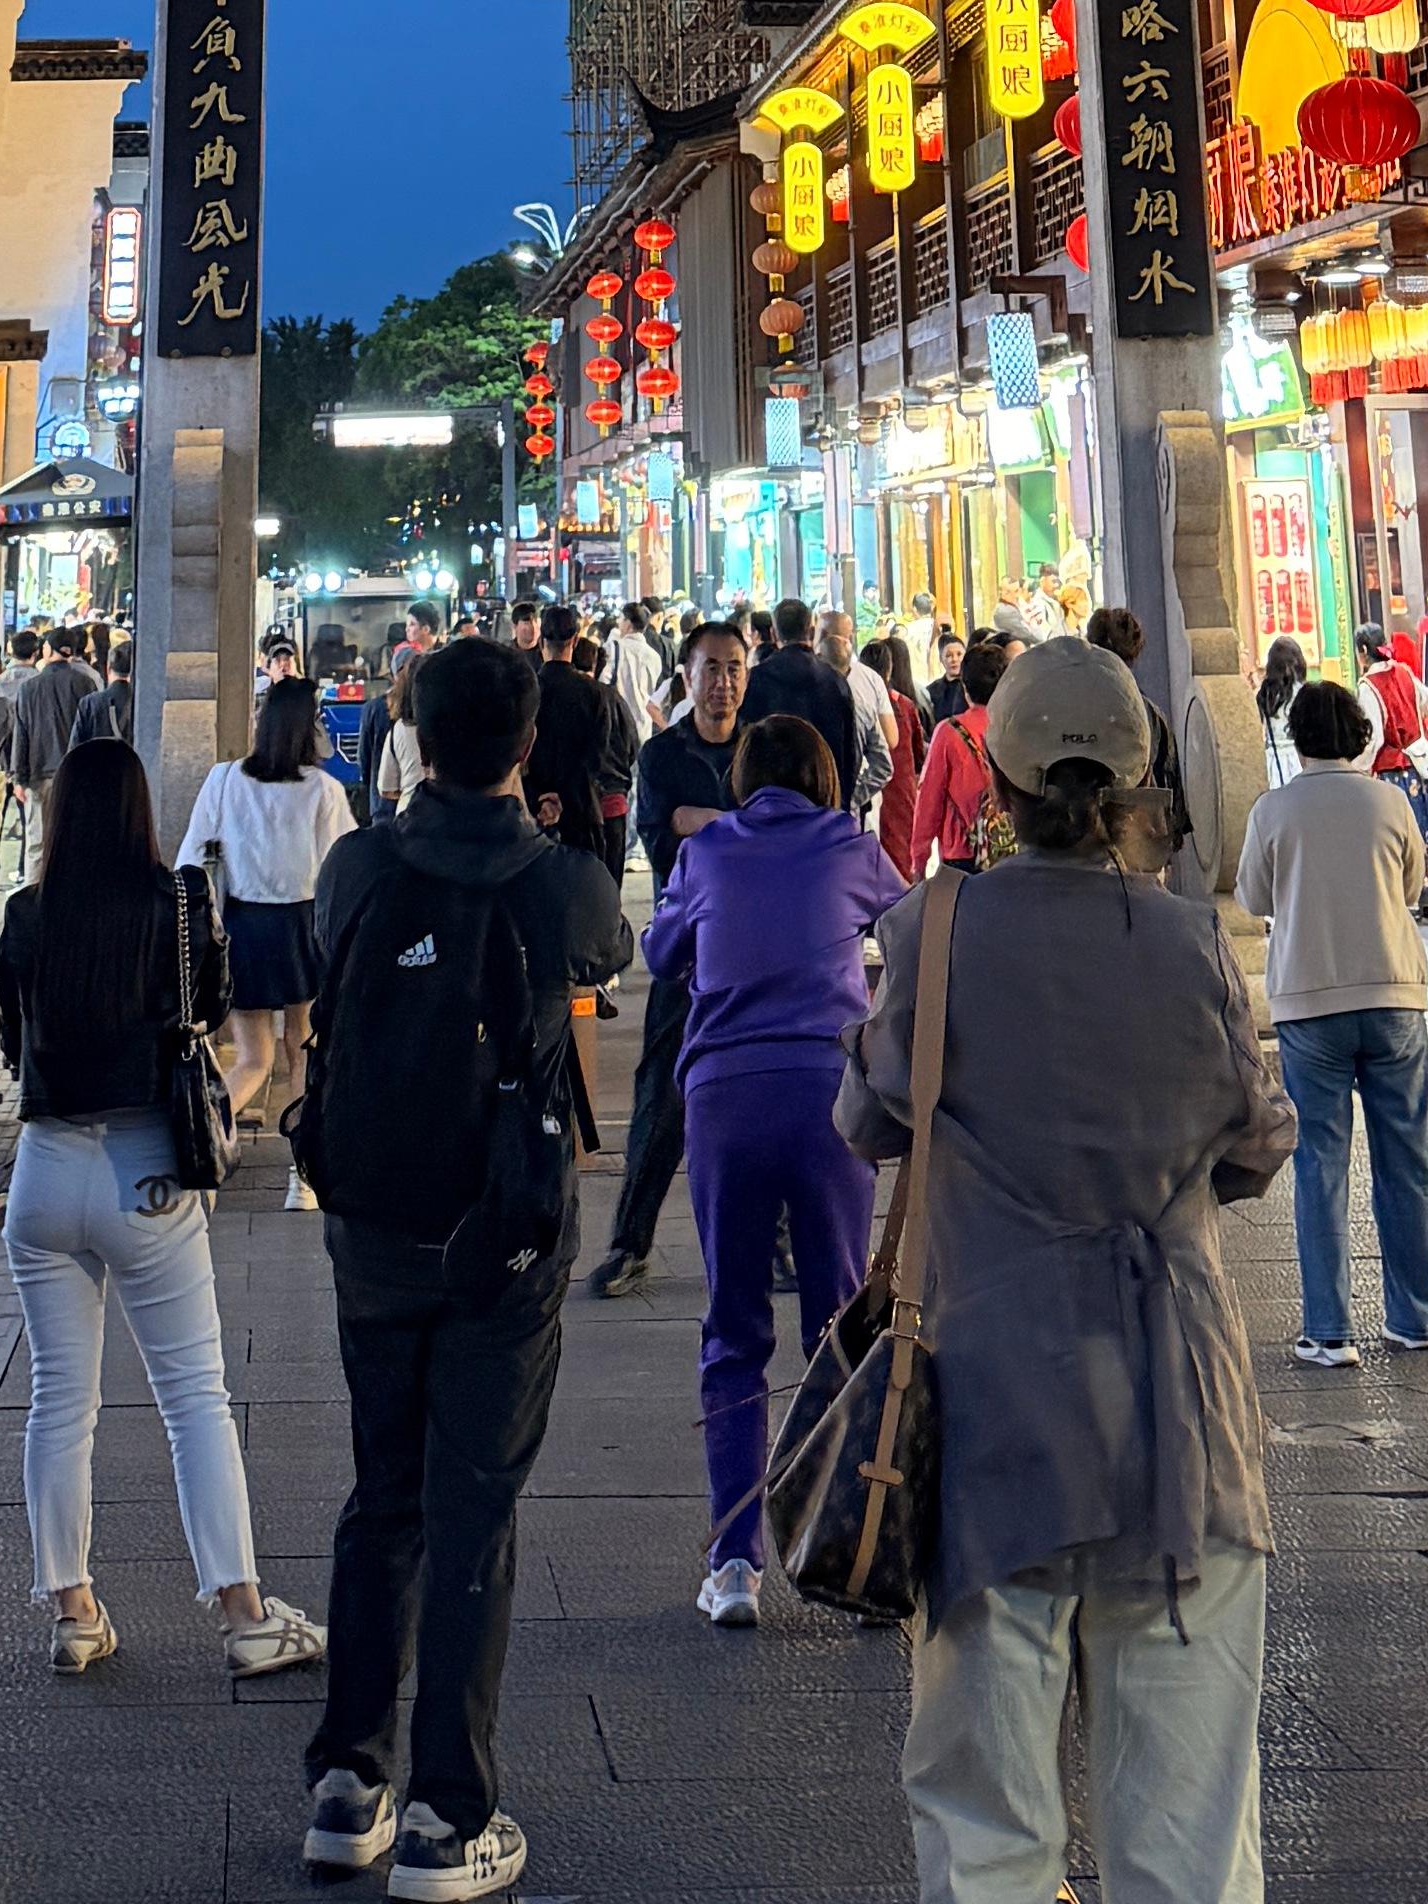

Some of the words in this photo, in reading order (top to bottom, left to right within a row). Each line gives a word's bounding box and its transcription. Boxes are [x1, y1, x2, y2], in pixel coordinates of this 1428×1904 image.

[876, 79, 905, 174] 小厨娘
[791, 154, 816, 237] 小厨娘
[1061, 733, 1099, 744] POLO
